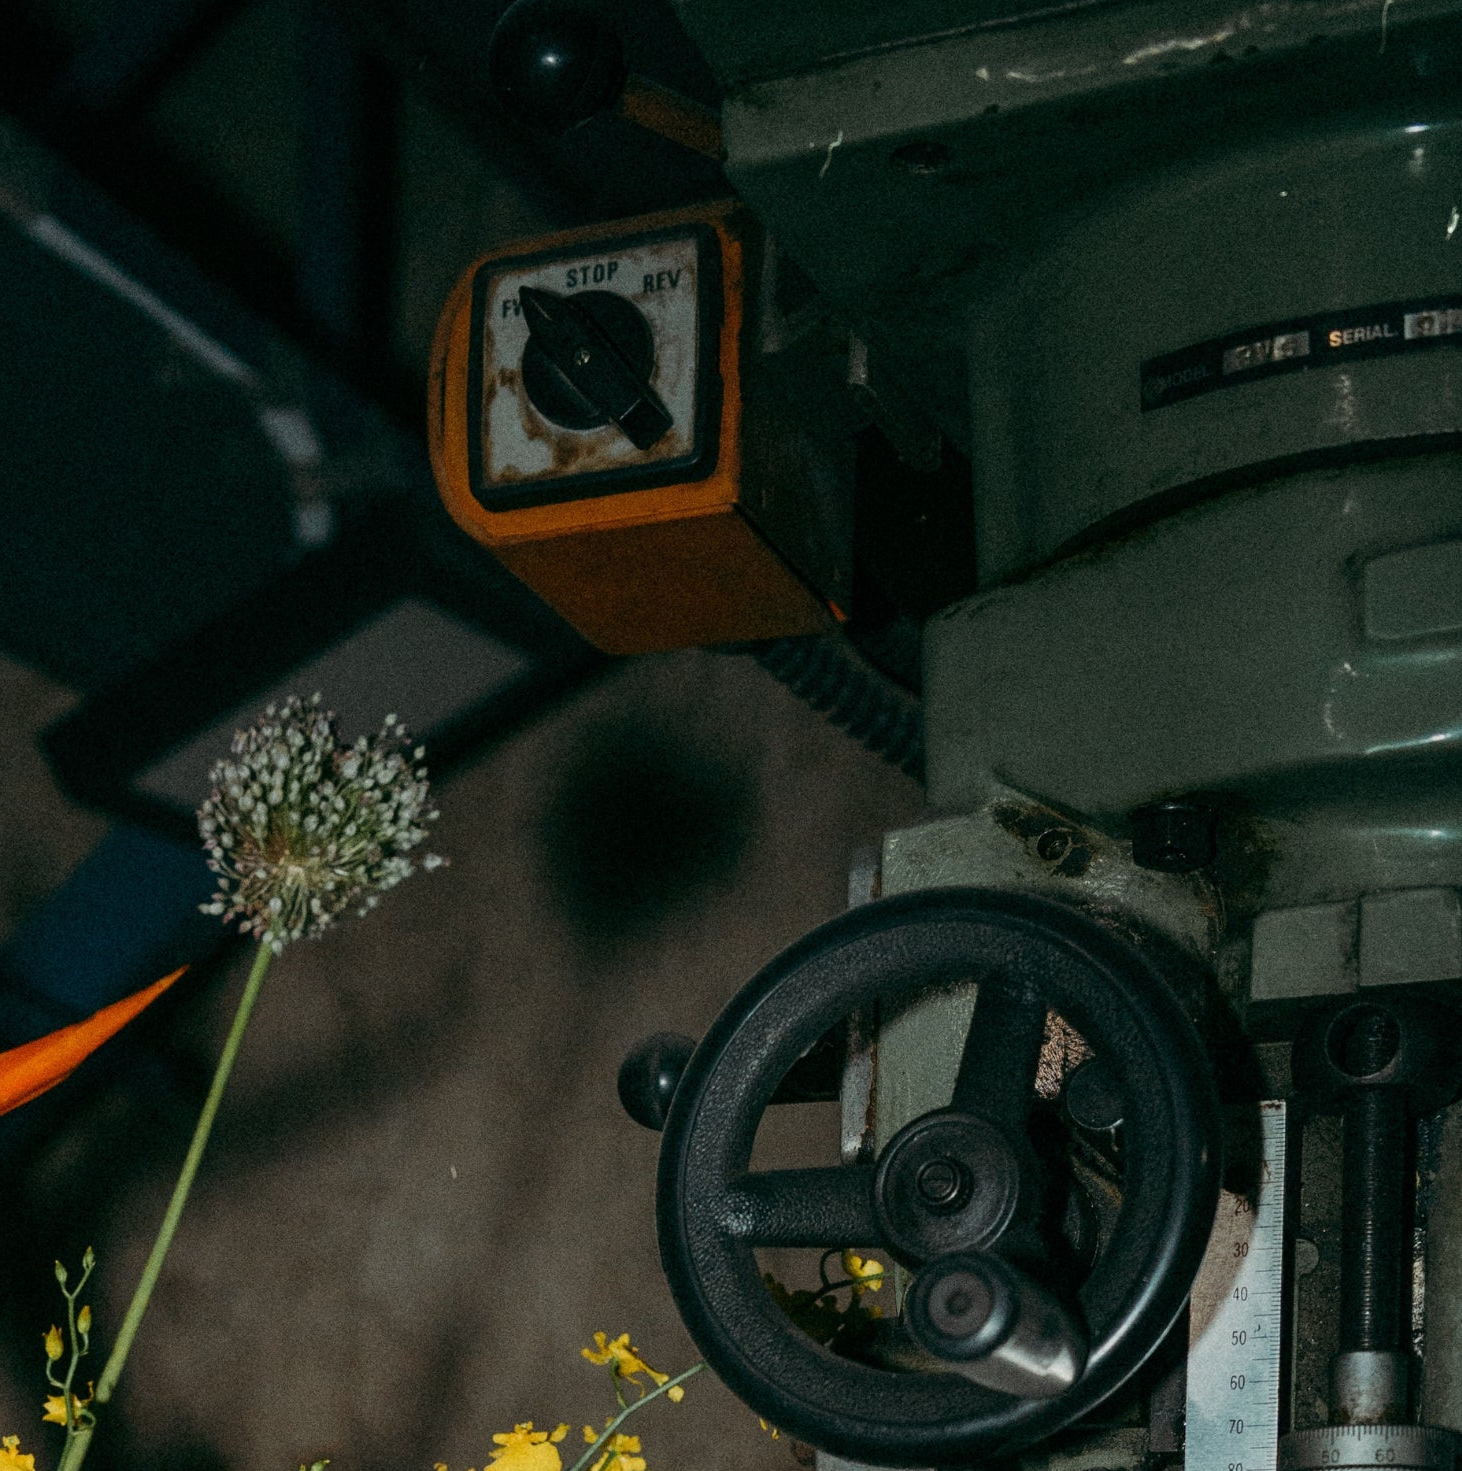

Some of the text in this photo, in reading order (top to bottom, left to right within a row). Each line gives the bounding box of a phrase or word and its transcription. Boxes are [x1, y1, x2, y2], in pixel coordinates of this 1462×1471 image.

[566, 261, 619, 288] STOP
[642, 268, 682, 293] REV
[1233, 1242, 1249, 1258] 30
[1232, 1286, 1248, 1302] 40
[1232, 1330, 1248, 1346] 50
[1230, 1374, 1246, 1390] 60
[1229, 1418, 1245, 1434] 70
[1375, 1447, 1396, 1464] 60
